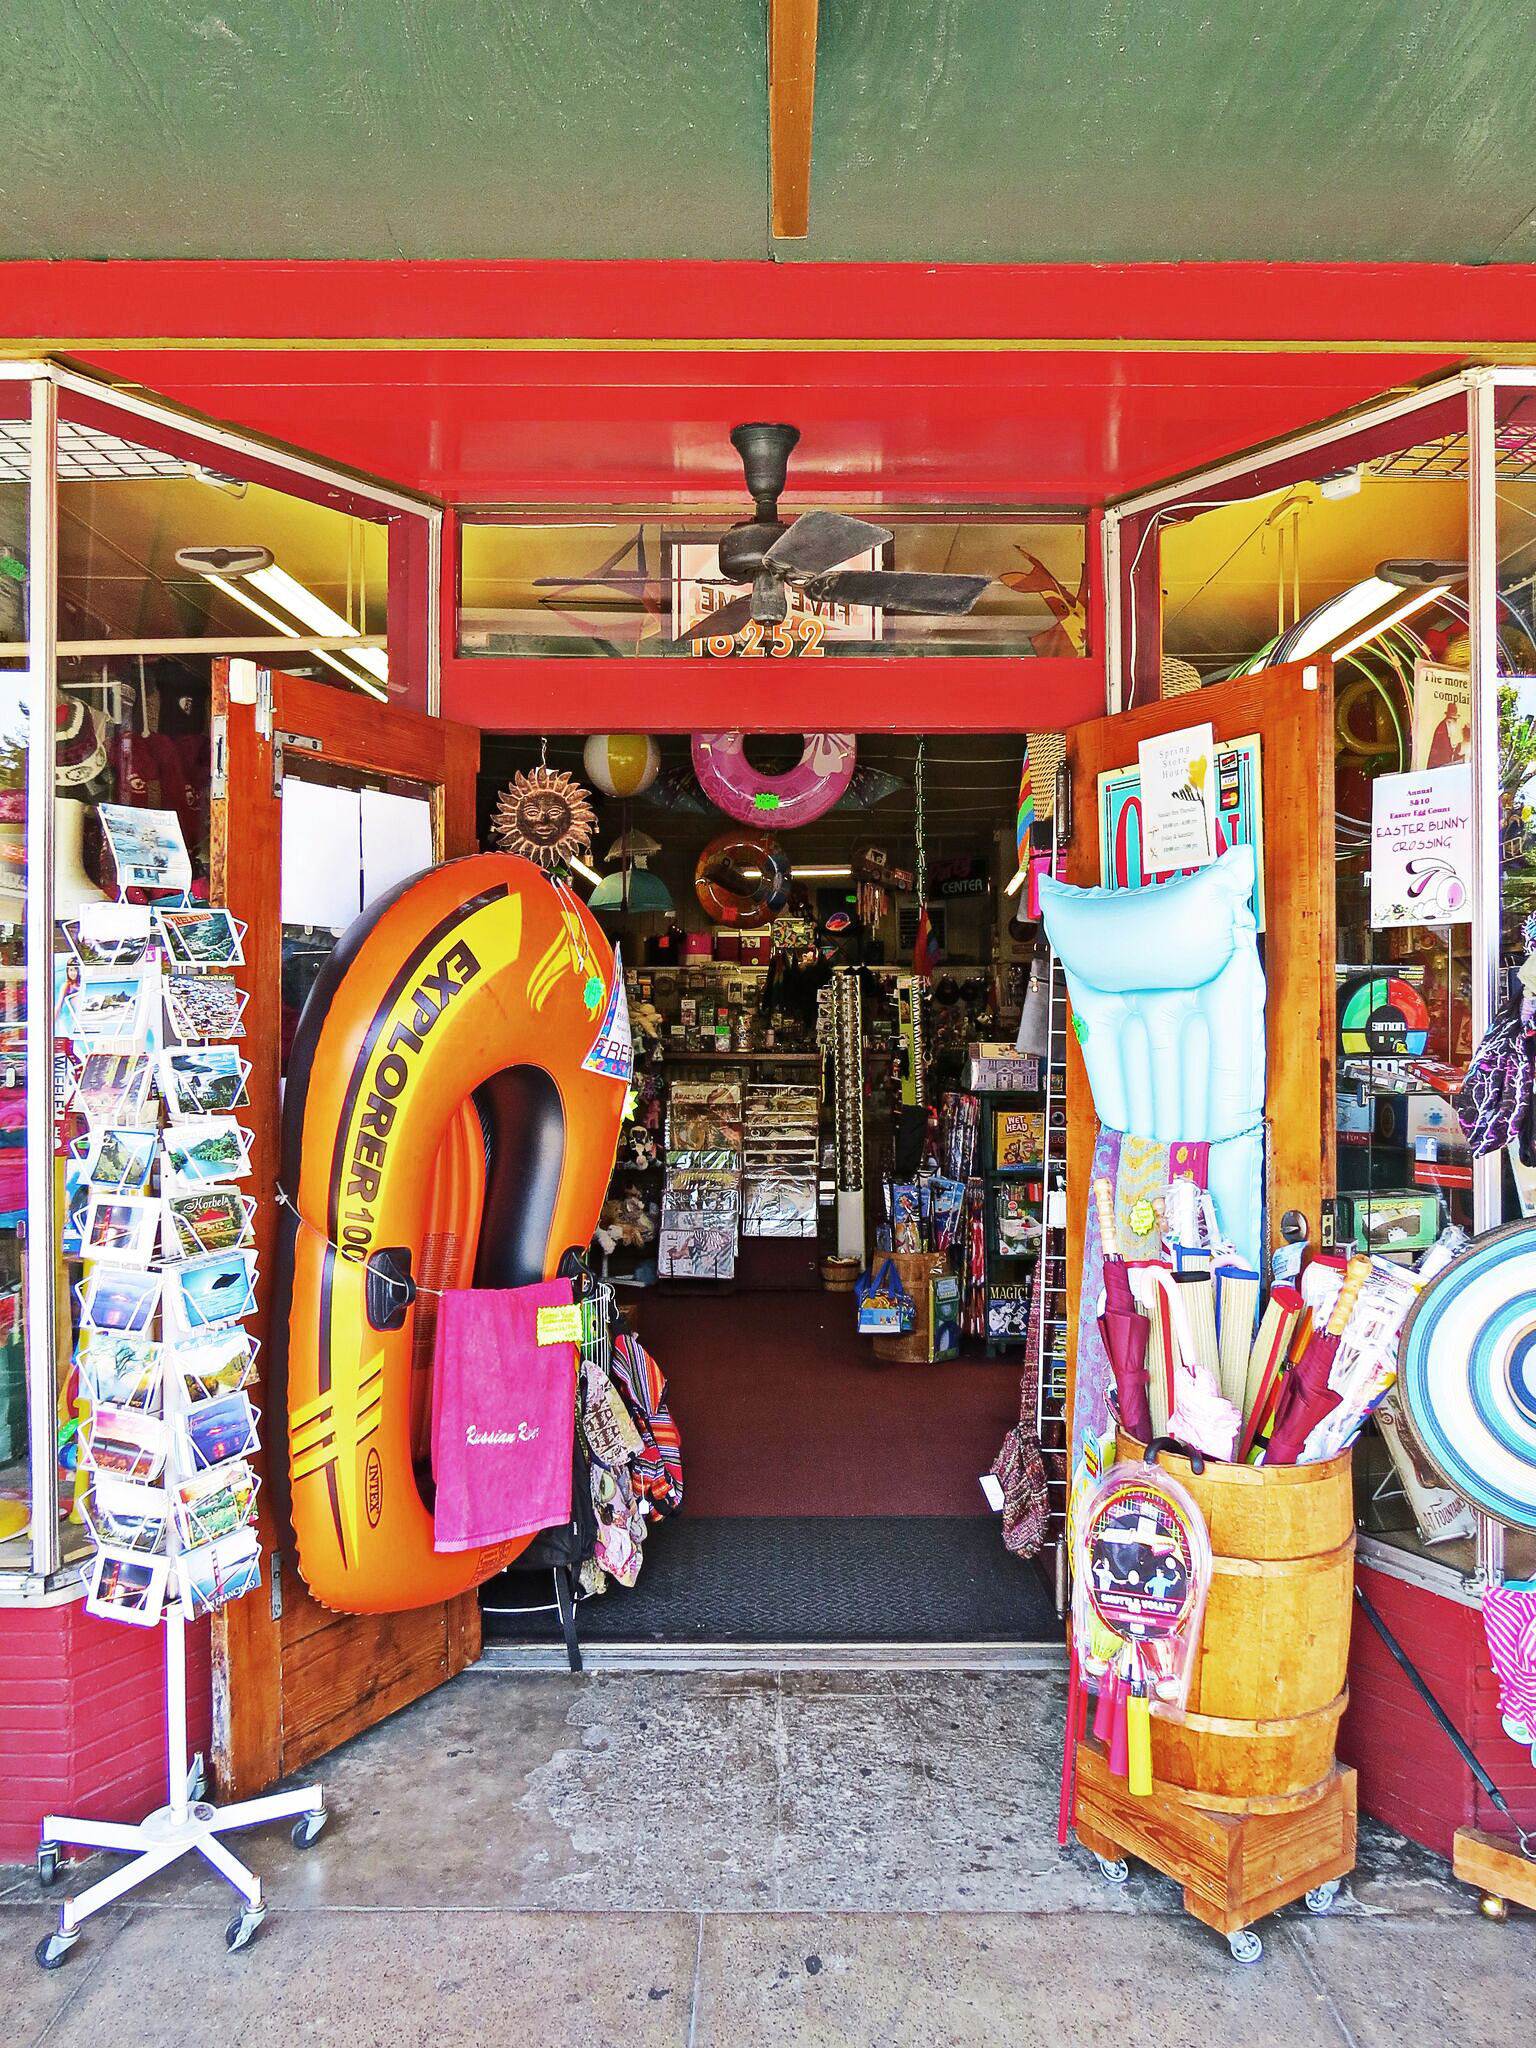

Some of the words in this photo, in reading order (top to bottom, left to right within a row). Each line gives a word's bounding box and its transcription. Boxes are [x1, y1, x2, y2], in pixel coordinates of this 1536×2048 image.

[1445, 677, 1468, 689] more
[1160, 745, 1190, 760] Spring
[1163, 757, 1187, 769] Store
[1407, 787, 1433, 797] Annual
[1390, 812, 1411, 820] Easter
[1376, 822, 1426, 838] EASTER
[1428, 815, 1469, 832] BUNNY
[1392, 835, 1453, 853] CROSSING
[942, 878, 983, 895] CENTER
[347, 939, 482, 1203] EXPLORER
[1006, 1123, 1028, 1132] HEAD
[1007, 1115, 1025, 1125] WET
[341, 1208, 375, 1263] 100
[466, 1424, 517, 1446] Russian
[368, 1462, 379, 1515] INTEX
